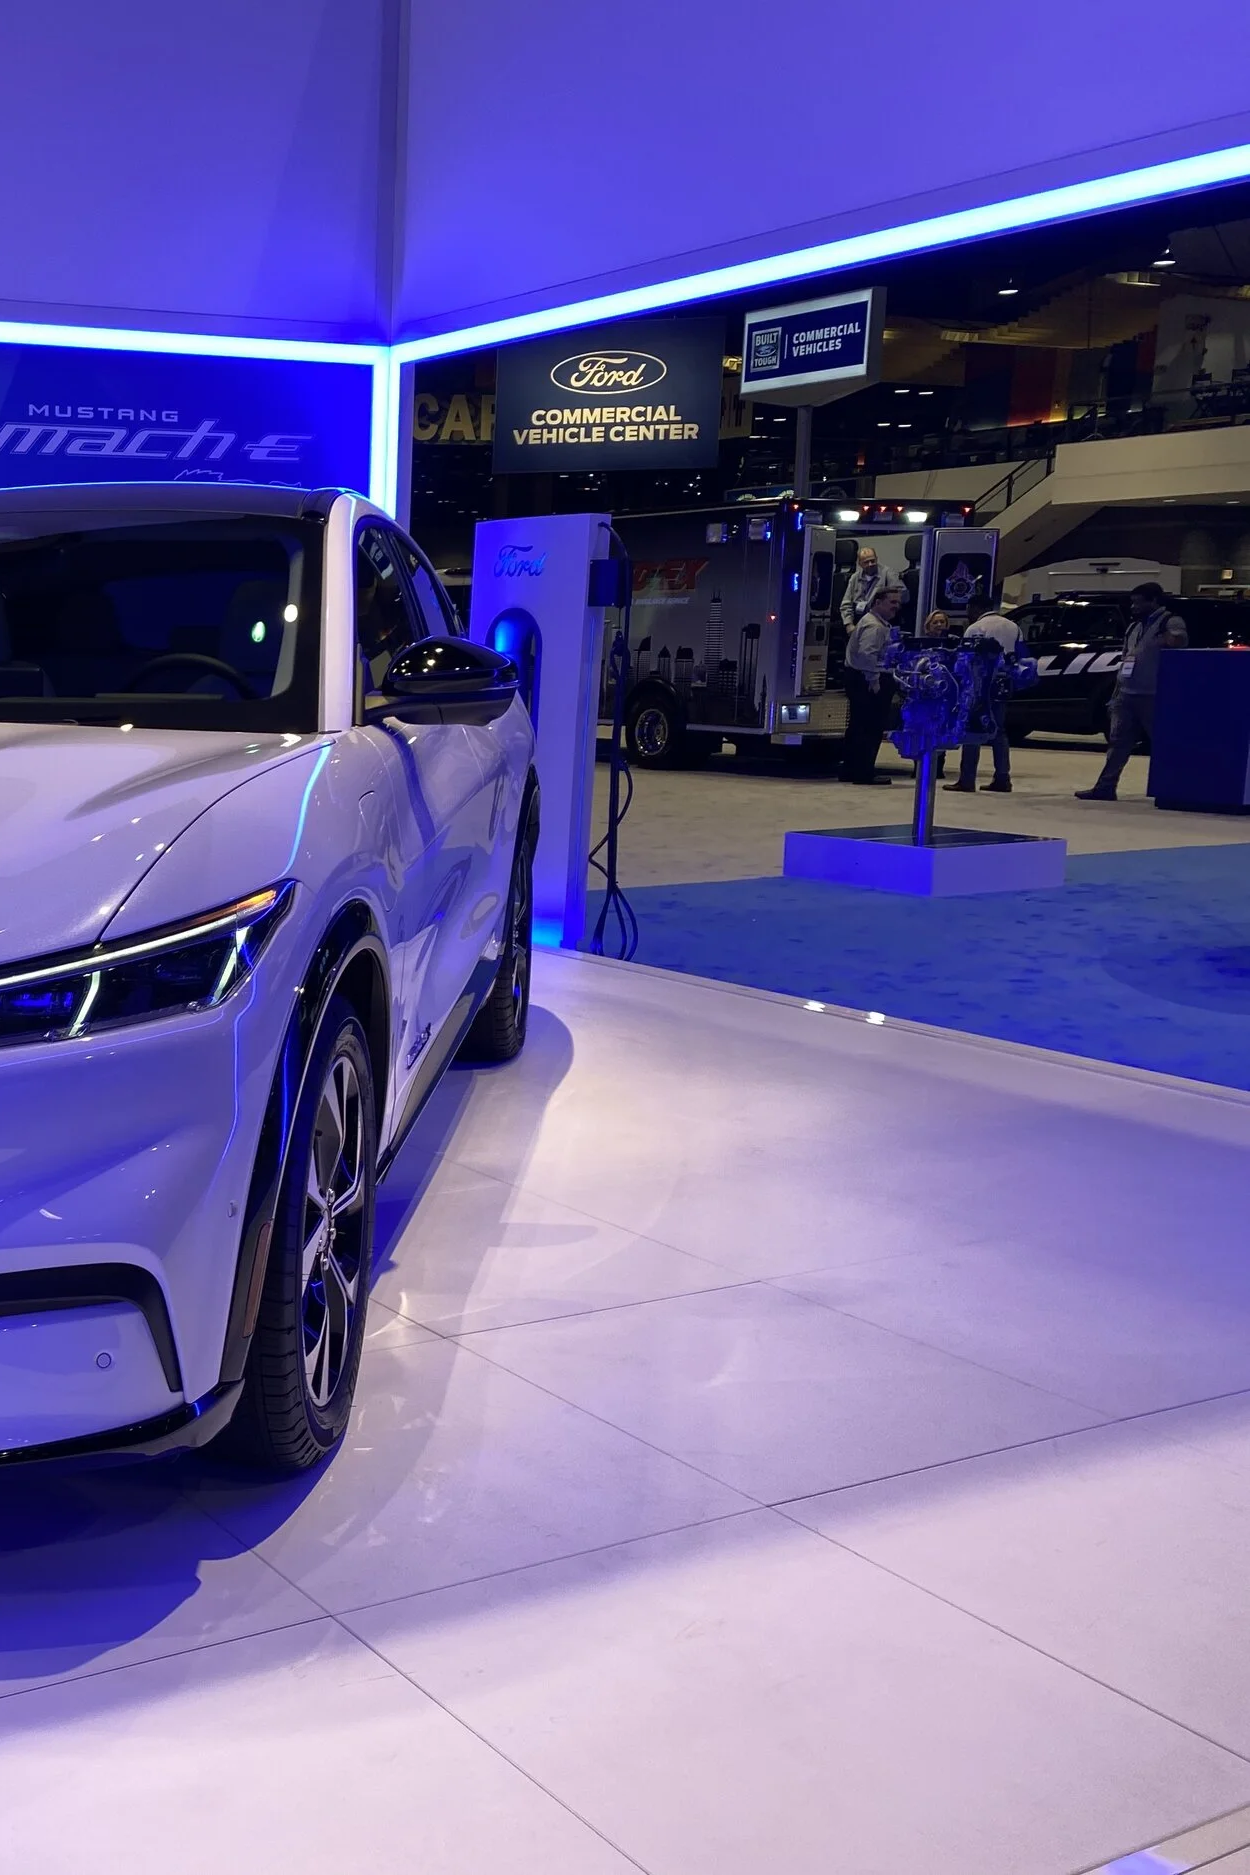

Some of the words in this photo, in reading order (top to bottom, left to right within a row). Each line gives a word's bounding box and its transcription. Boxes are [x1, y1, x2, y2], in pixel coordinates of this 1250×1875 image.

[755, 332, 778, 346] BUILT
[792, 321, 861, 344] COMMERCIAL
[792, 339, 842, 357] VEHICLES
[754, 356, 777, 367] TOUGH
[570, 357, 647, 388] Ford
[28, 404, 179, 423] MUSTANG
[531, 405, 682, 426] COMMERCIAL
[513, 427, 605, 445] VEHICLE
[609, 423, 699, 442] CENTER
[493, 545, 547, 577] Ford
[1037, 652, 1124, 676] LIC
